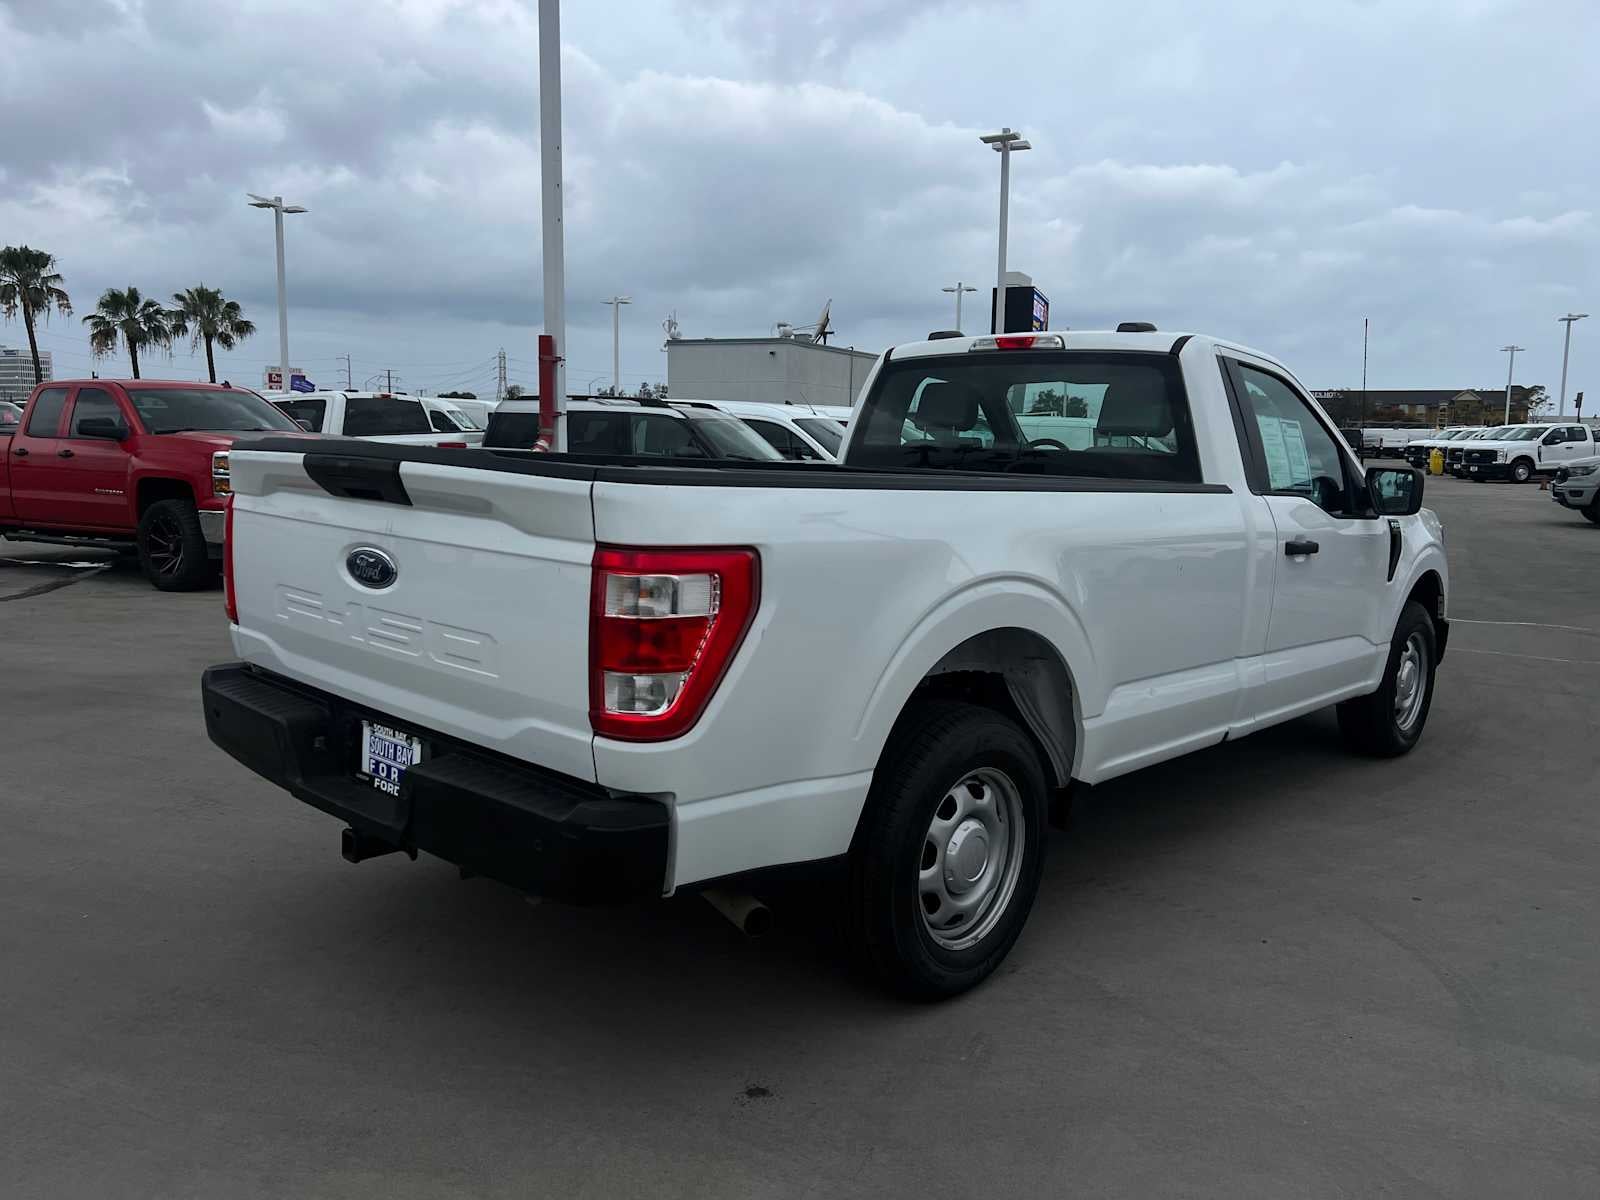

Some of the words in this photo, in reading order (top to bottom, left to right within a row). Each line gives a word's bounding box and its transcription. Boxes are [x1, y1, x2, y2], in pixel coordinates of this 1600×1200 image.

[276, 584, 499, 678] F-150
[370, 736, 394, 759] SOUTH
[396, 745, 413, 766] BAY
